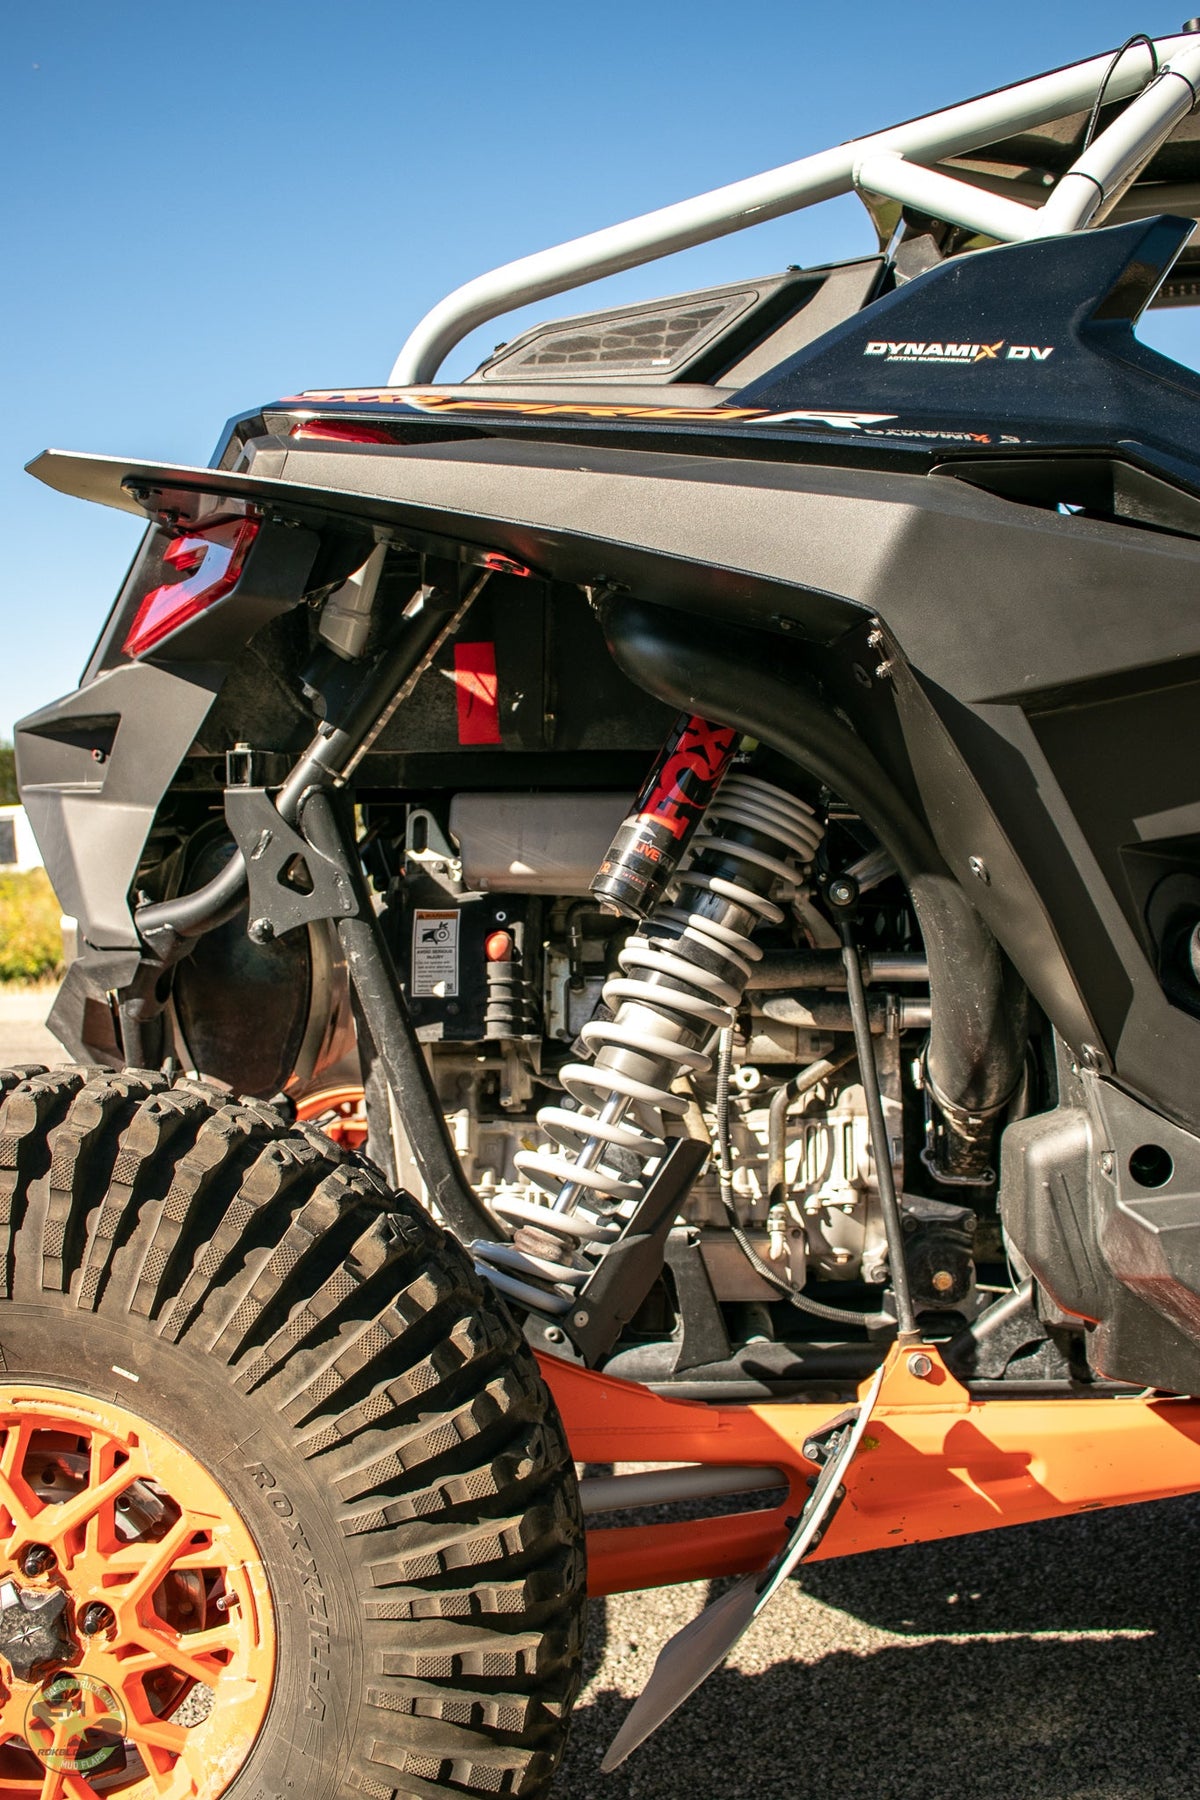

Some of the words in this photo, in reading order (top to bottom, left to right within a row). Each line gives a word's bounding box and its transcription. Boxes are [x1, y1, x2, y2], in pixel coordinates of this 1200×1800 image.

[863, 339, 1005, 362] DYNAMIX
[1005, 345, 1054, 360] DV
[637, 715, 737, 841] FOX
